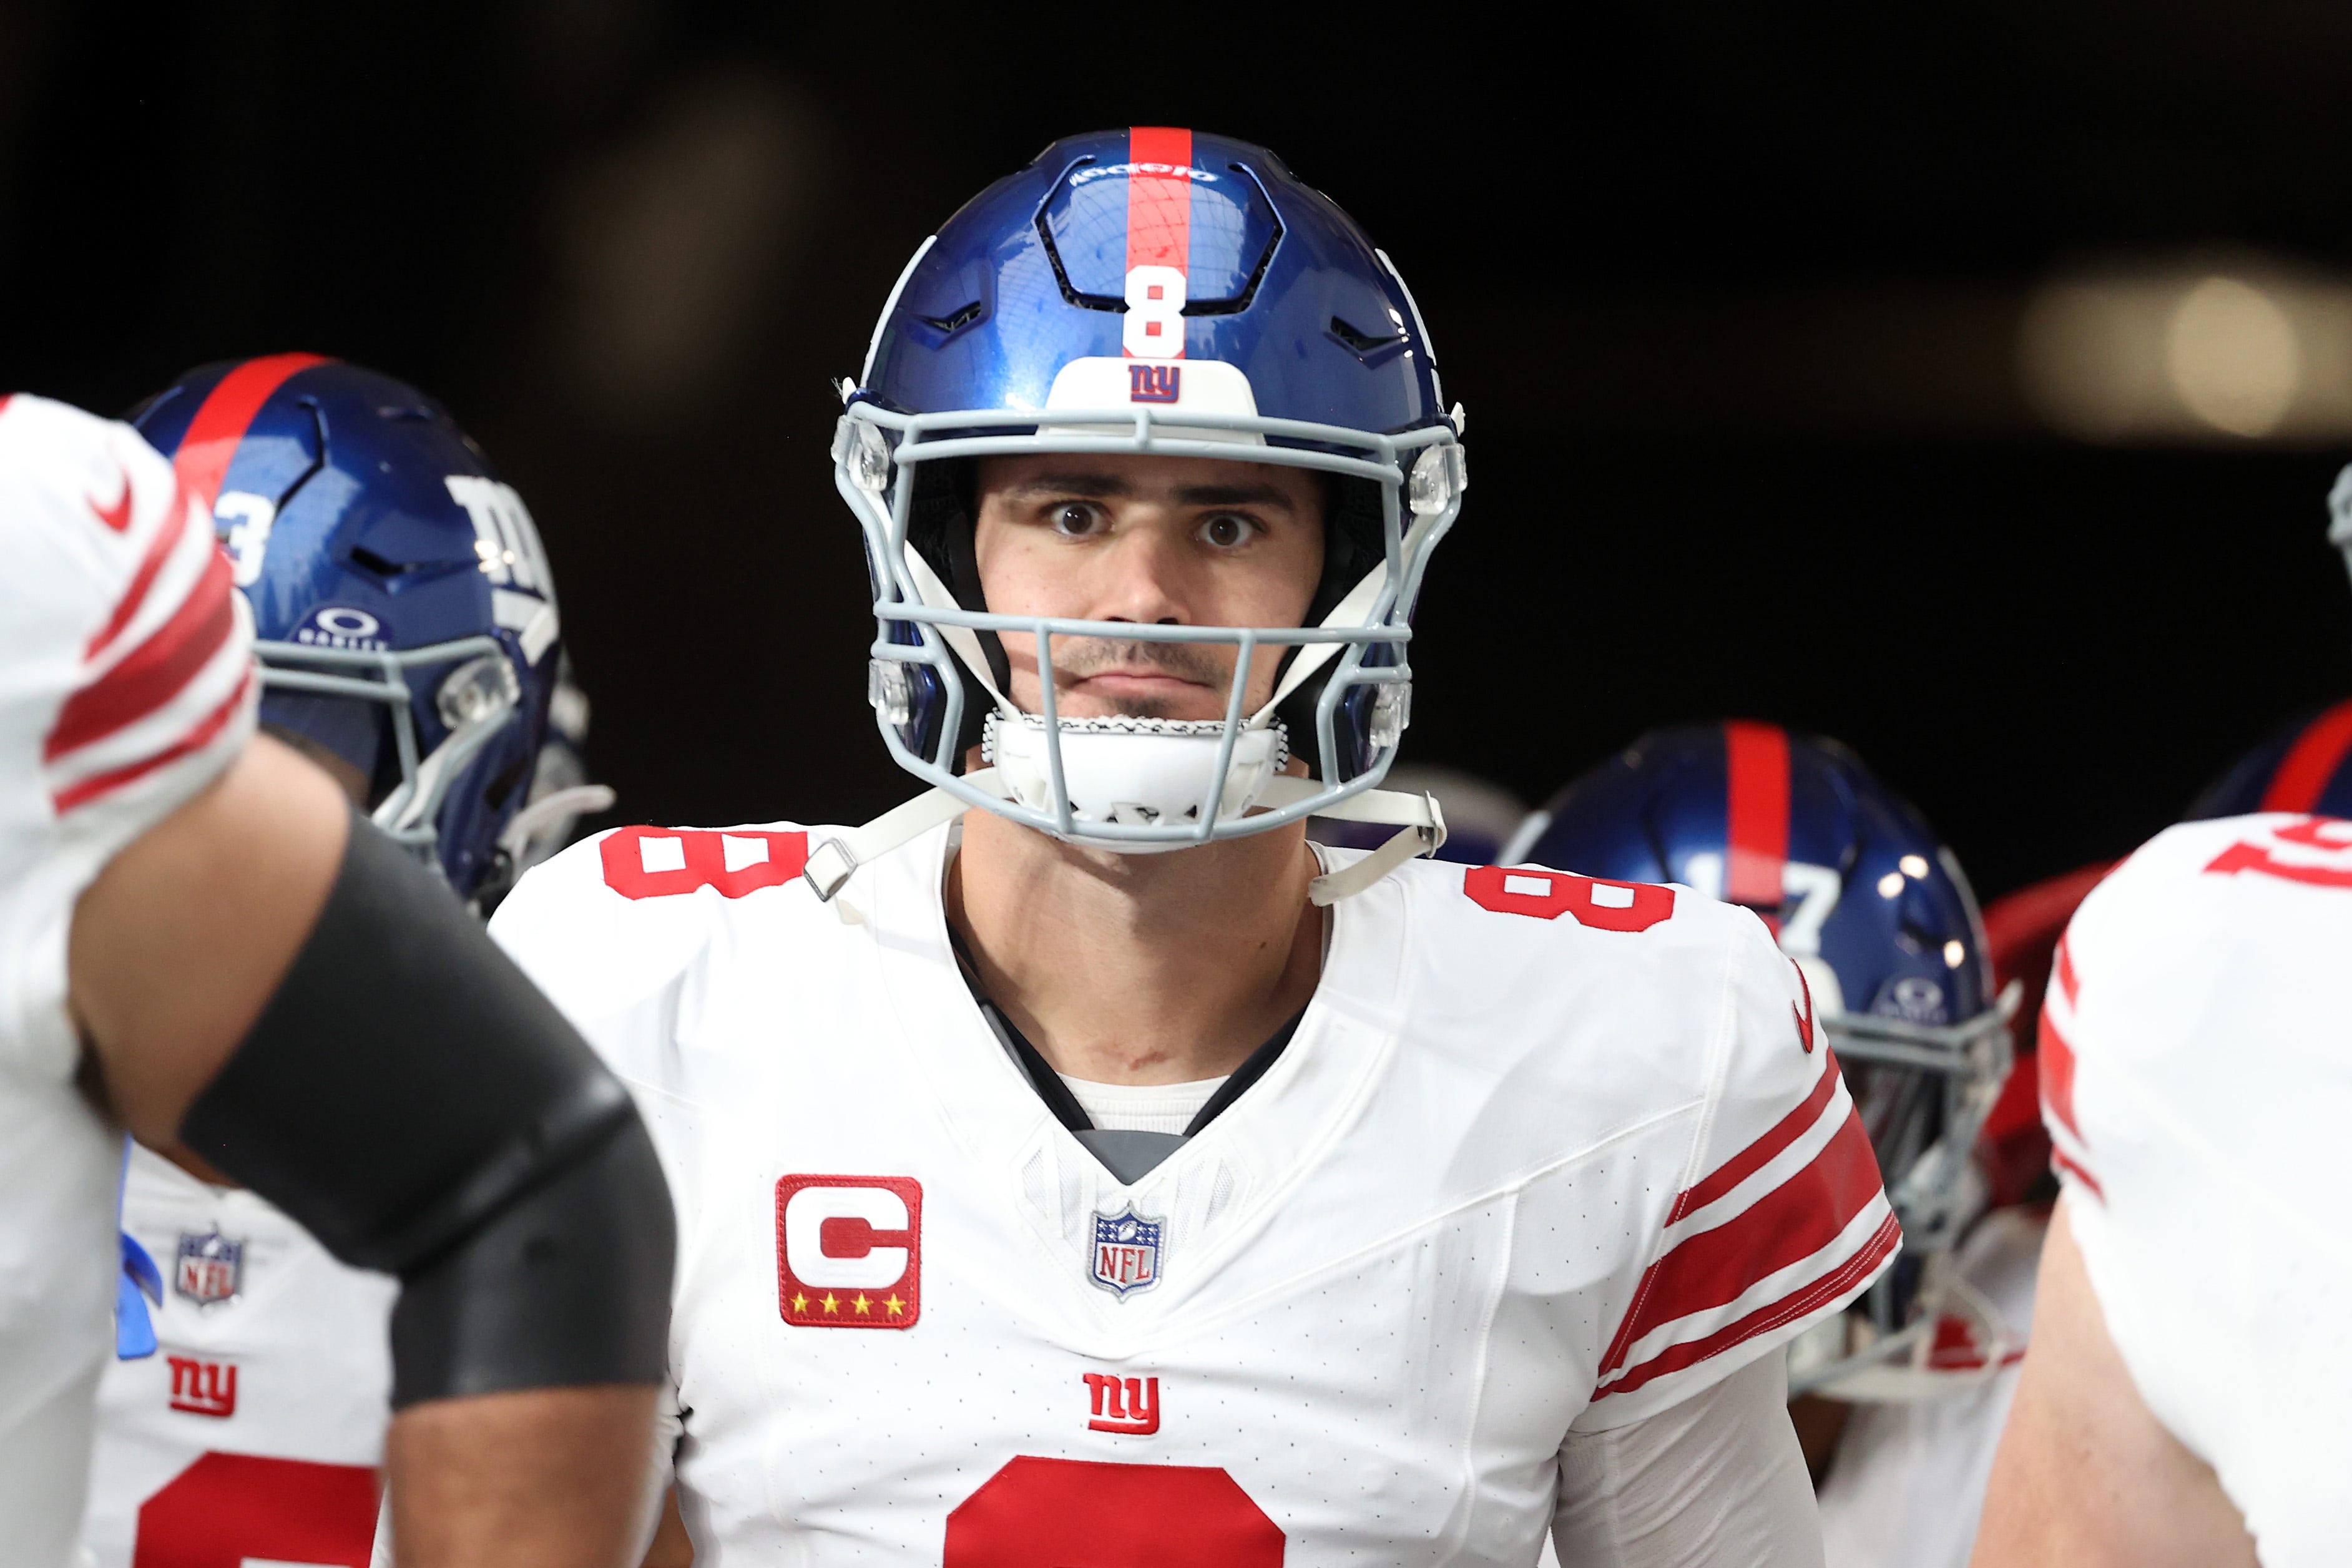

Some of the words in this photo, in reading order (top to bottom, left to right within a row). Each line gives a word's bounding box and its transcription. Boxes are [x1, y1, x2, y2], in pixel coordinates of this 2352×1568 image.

[1124, 265, 1186, 358] 8
[600, 825, 808, 900] 8
[1464, 865, 1675, 933] 8
[785, 1186, 910, 1289] C
[1100, 1246, 1150, 1284] NFL
[182, 1263, 233, 1297] NFL
